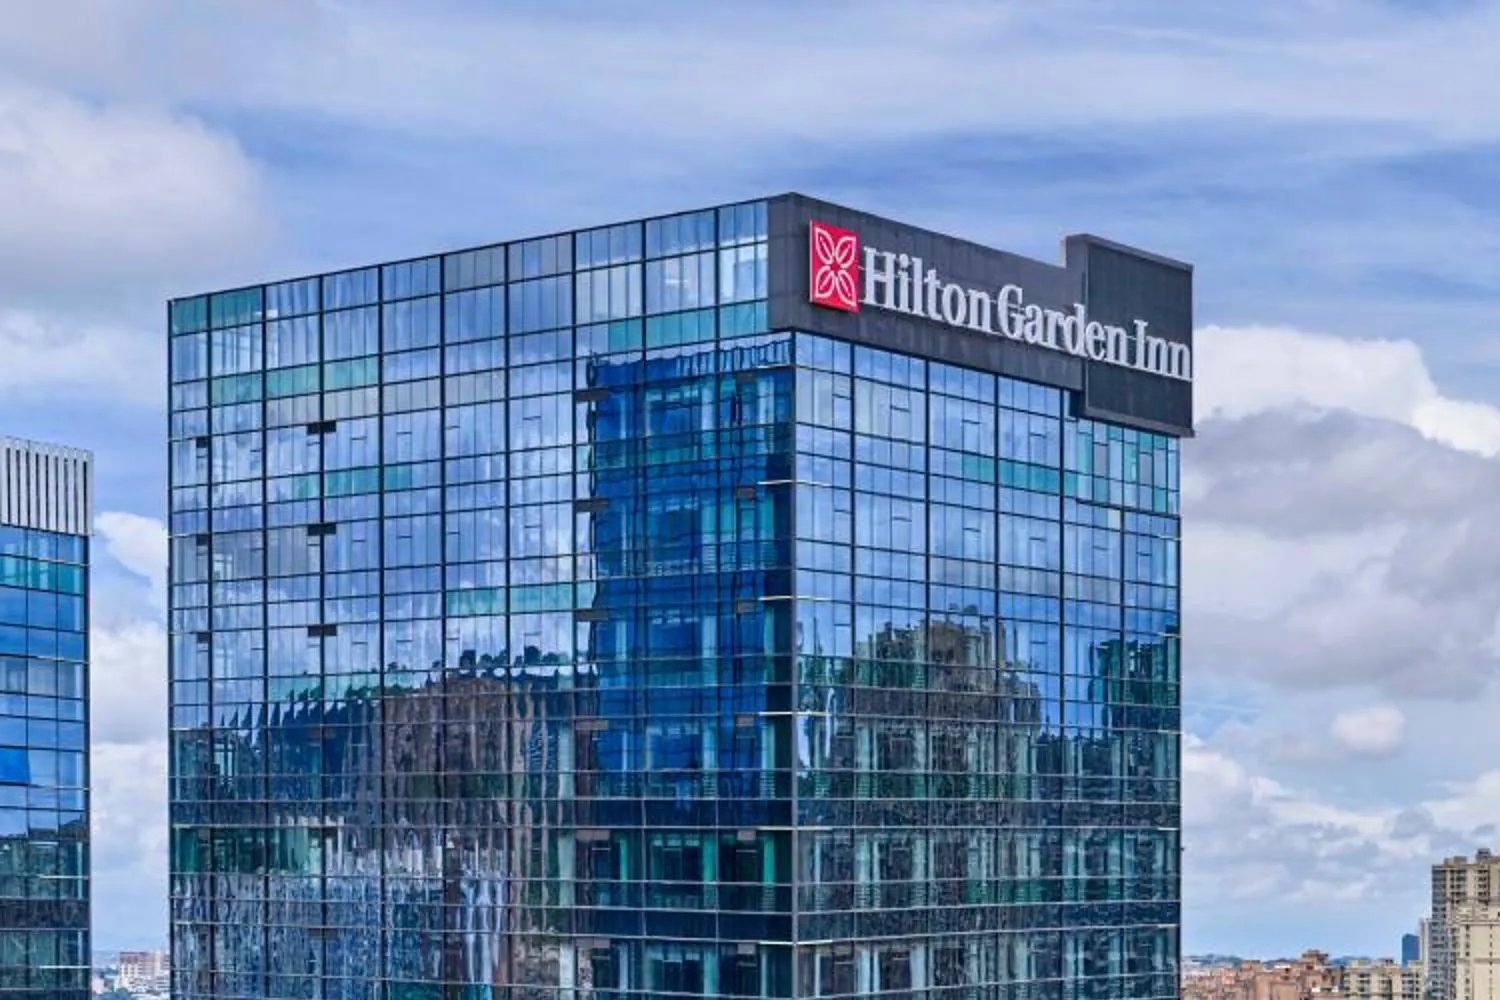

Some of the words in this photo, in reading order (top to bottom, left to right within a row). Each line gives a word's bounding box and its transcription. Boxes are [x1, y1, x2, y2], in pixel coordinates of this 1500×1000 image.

[863, 246, 993, 333] Hilton
[998, 284, 1130, 366] Garden
[1133, 319, 1192, 382] Inn
